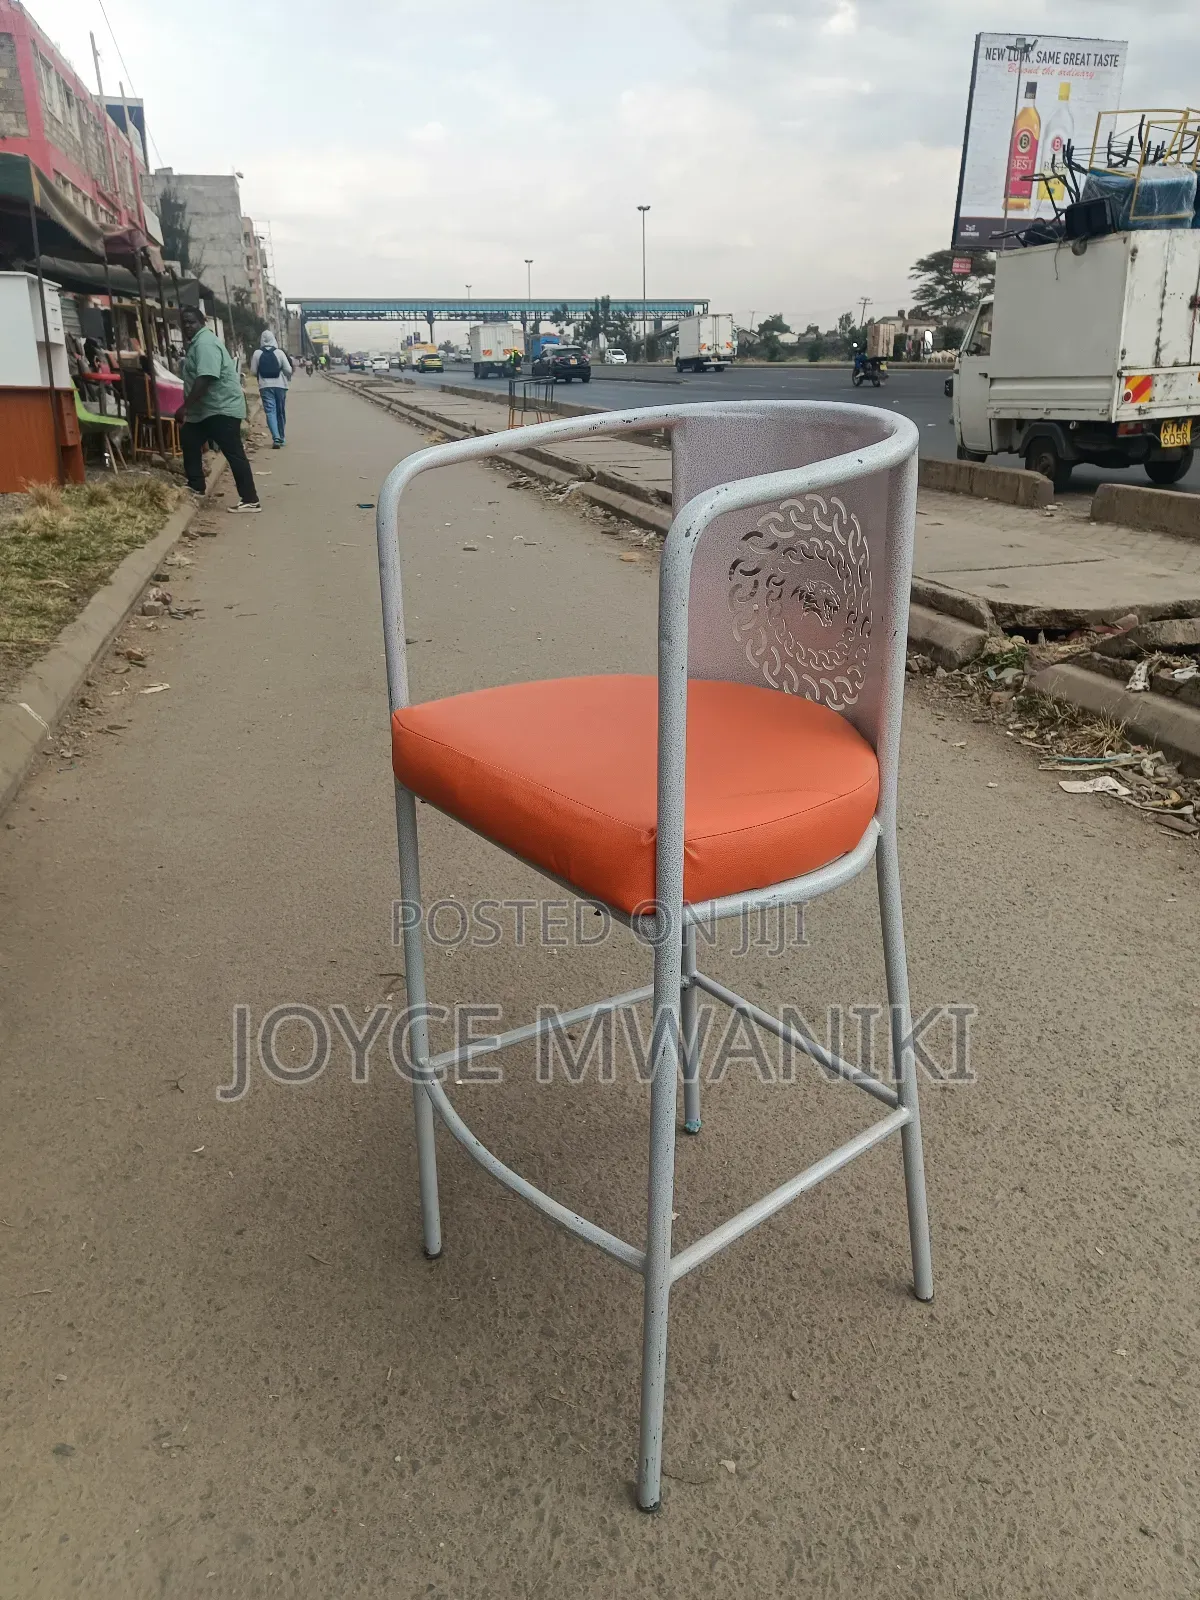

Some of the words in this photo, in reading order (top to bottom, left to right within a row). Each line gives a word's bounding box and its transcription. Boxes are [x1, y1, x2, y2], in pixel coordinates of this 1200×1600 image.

[985, 47, 1006, 61] NEW
[1036, 50, 1061, 65] SAME
[1063, 52, 1091, 66] GREAT
[1093, 53, 1120, 68] TASTE
[1163, 432, 1188, 445] 605R
